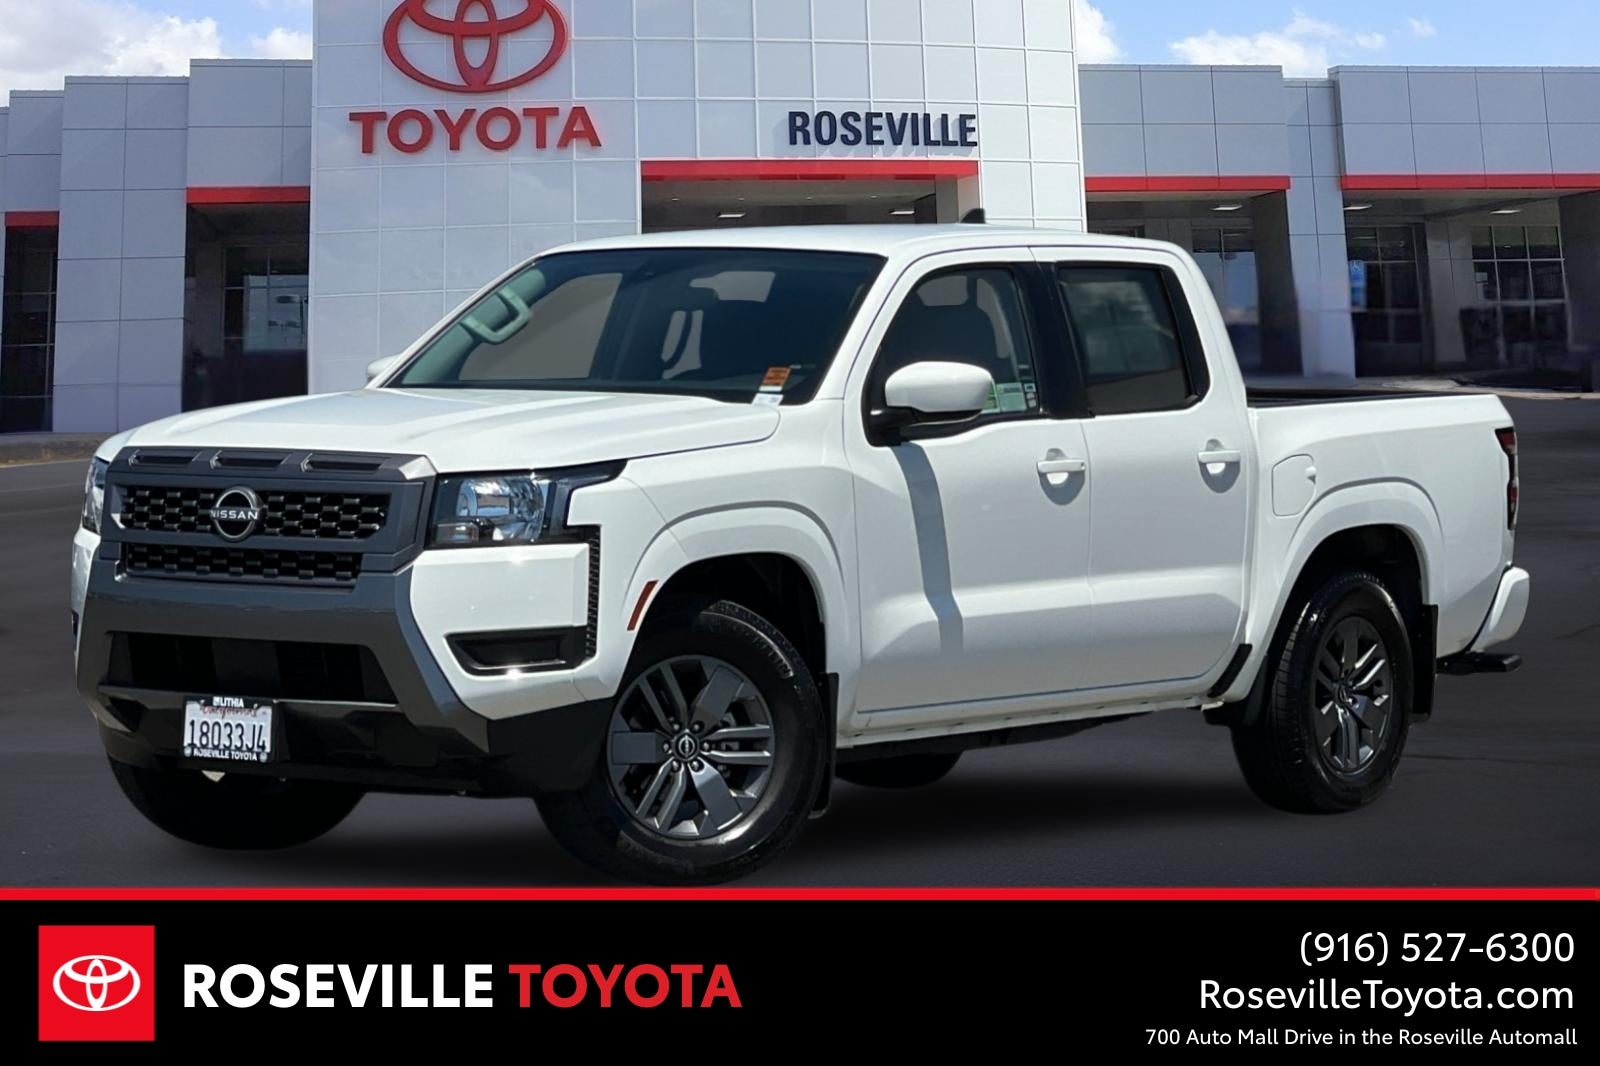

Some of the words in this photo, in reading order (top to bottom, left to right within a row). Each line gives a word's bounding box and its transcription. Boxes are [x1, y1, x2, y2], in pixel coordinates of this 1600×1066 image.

[349, 106, 602, 154] TOYOTA
[788, 110, 978, 147] ROSEVILLE
[210, 509, 258, 520] NISSAN
[220, 696, 245, 708] LITHIA
[188, 719, 267, 752] 18033J4
[193, 747, 230, 759] ROSEVILLE
[231, 750, 258, 761] TOYOTA
